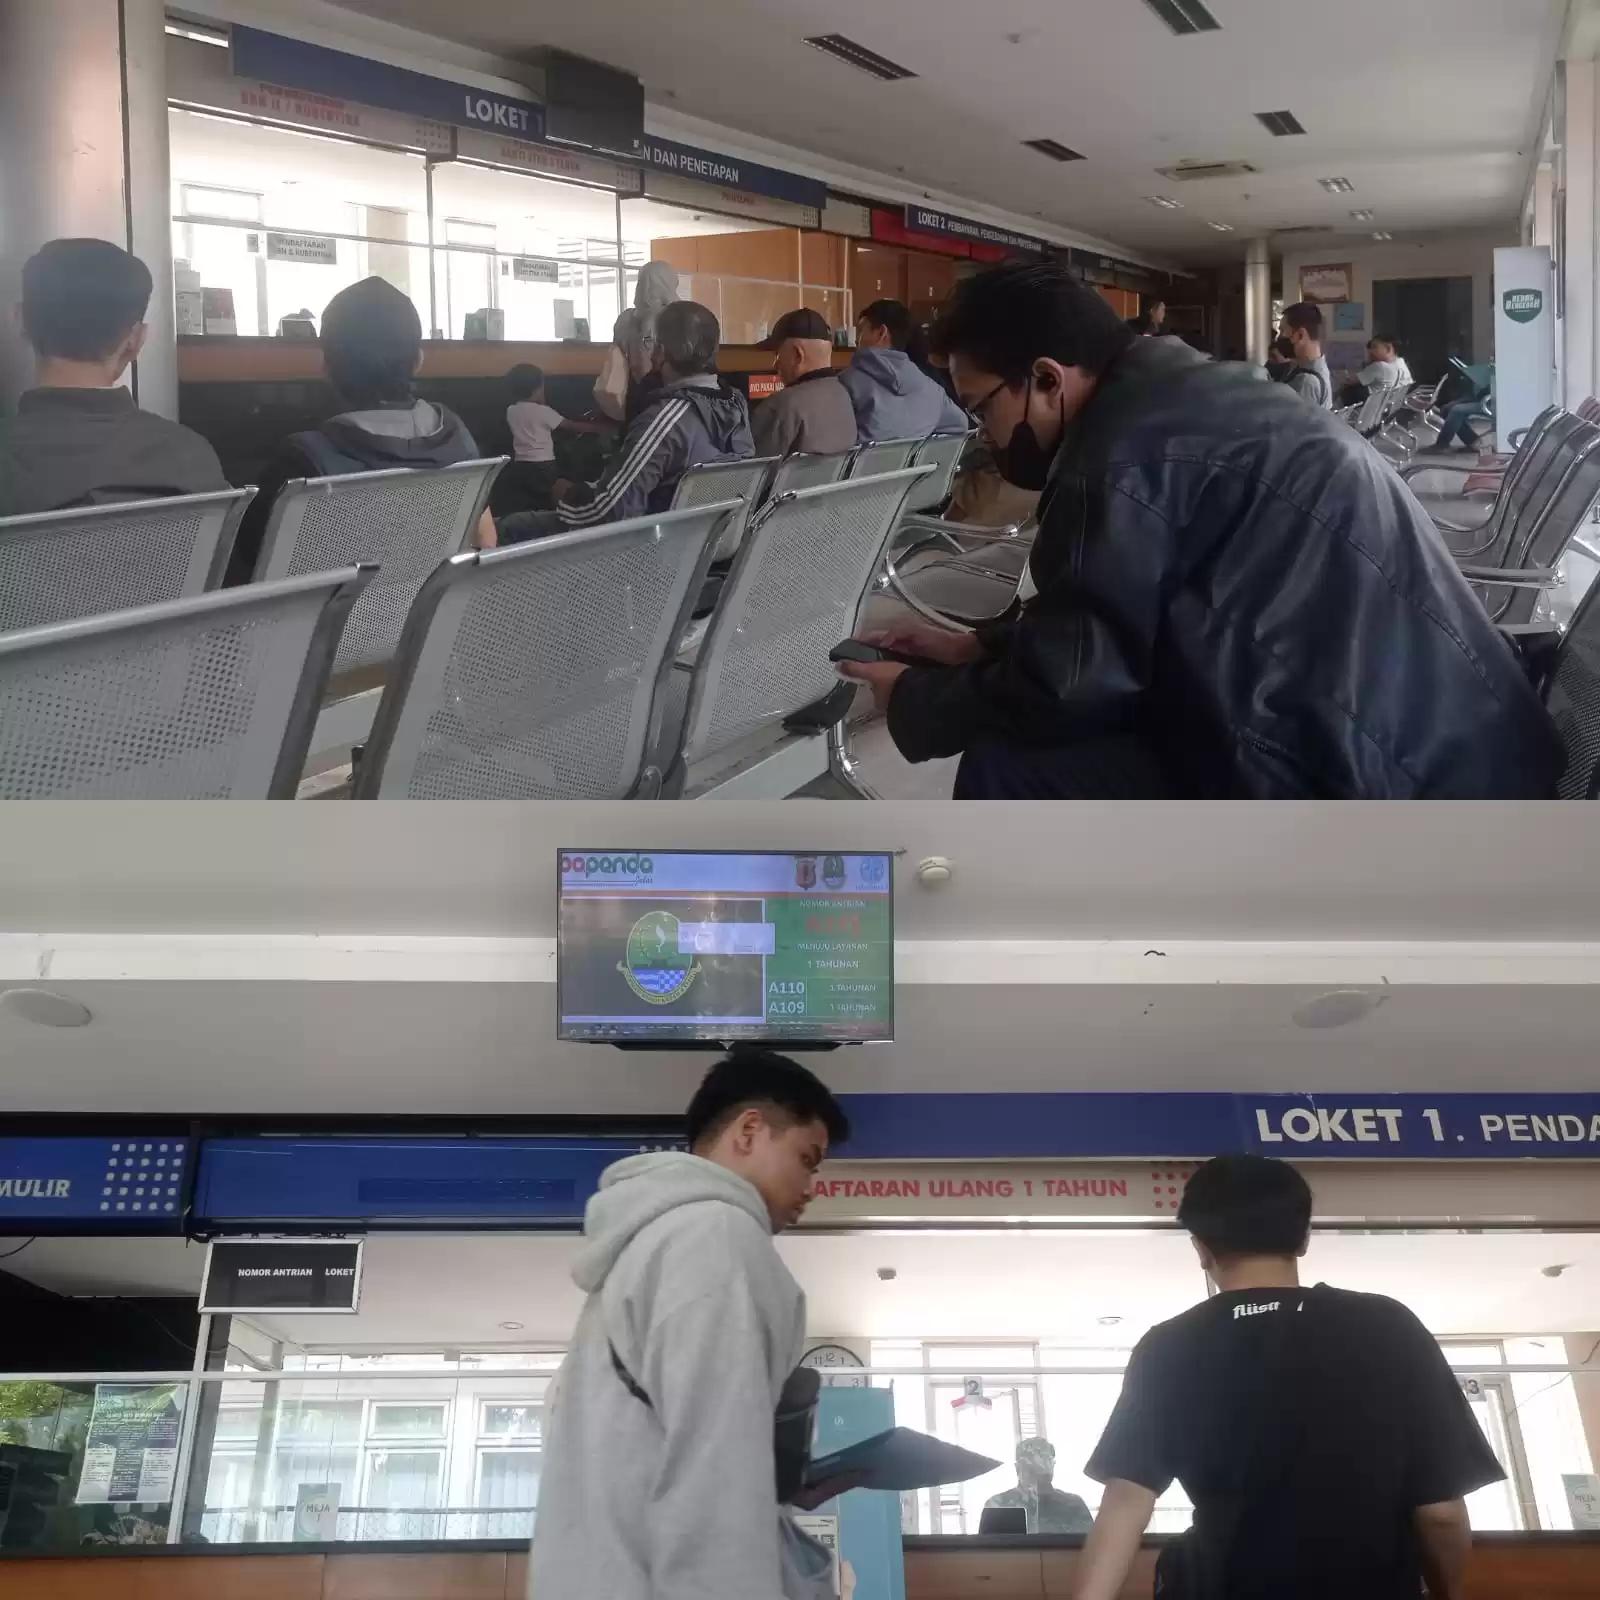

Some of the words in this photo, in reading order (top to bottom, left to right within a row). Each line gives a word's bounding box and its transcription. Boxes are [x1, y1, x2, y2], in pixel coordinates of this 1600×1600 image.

[465, 95, 528, 131] LOKET
[654, 147, 678, 169] DAN
[680, 154, 739, 184] PENETAPAN
[918, 211, 940, 230] LOKET
[940, 216, 946, 230] 2
[816, 959, 859, 969] TAHUNAN
[768, 981, 805, 995] A110
[768, 1001, 805, 1014] A109
[1255, 1108, 1403, 1142] LOKET
[812, 1179, 920, 1198] AFTARAN
[928, 1179, 1014, 1198] ULANG
[1022, 1180, 1033, 1197] 1
[1043, 1179, 1128, 1197] TAHUN
[237, 1267, 271, 1278] NOMOR
[272, 1267, 313, 1277] ANTRIAN
[324, 1267, 355, 1277] LOKET
[967, 1379, 981, 1396] 2
